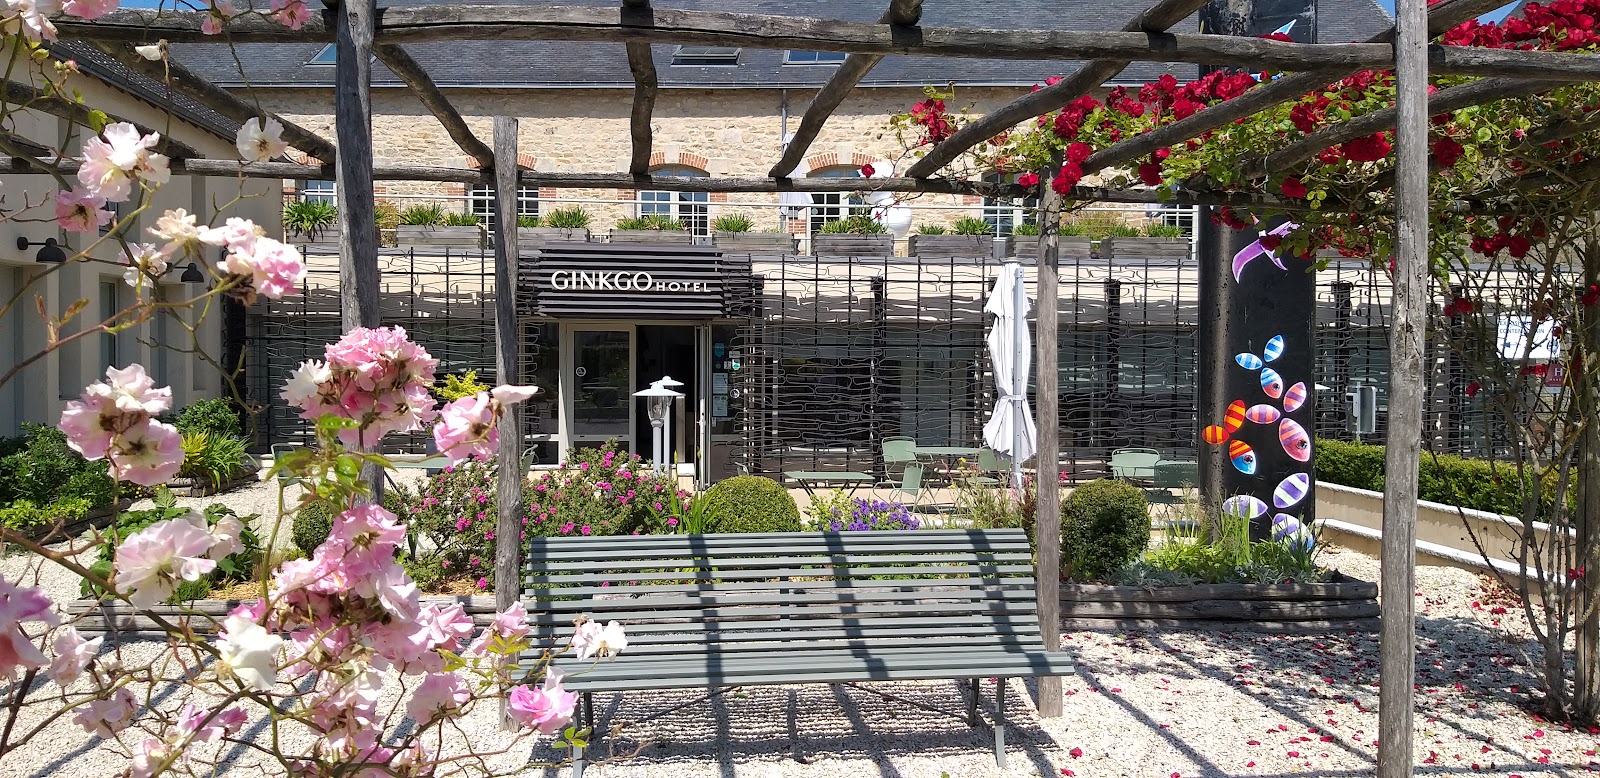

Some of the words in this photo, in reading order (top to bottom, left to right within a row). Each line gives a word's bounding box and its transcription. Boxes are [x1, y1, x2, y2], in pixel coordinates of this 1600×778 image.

[551, 270, 652, 291] GINKGO
[656, 281, 712, 293] HOTEL
[1554, 367, 1563, 377] H
